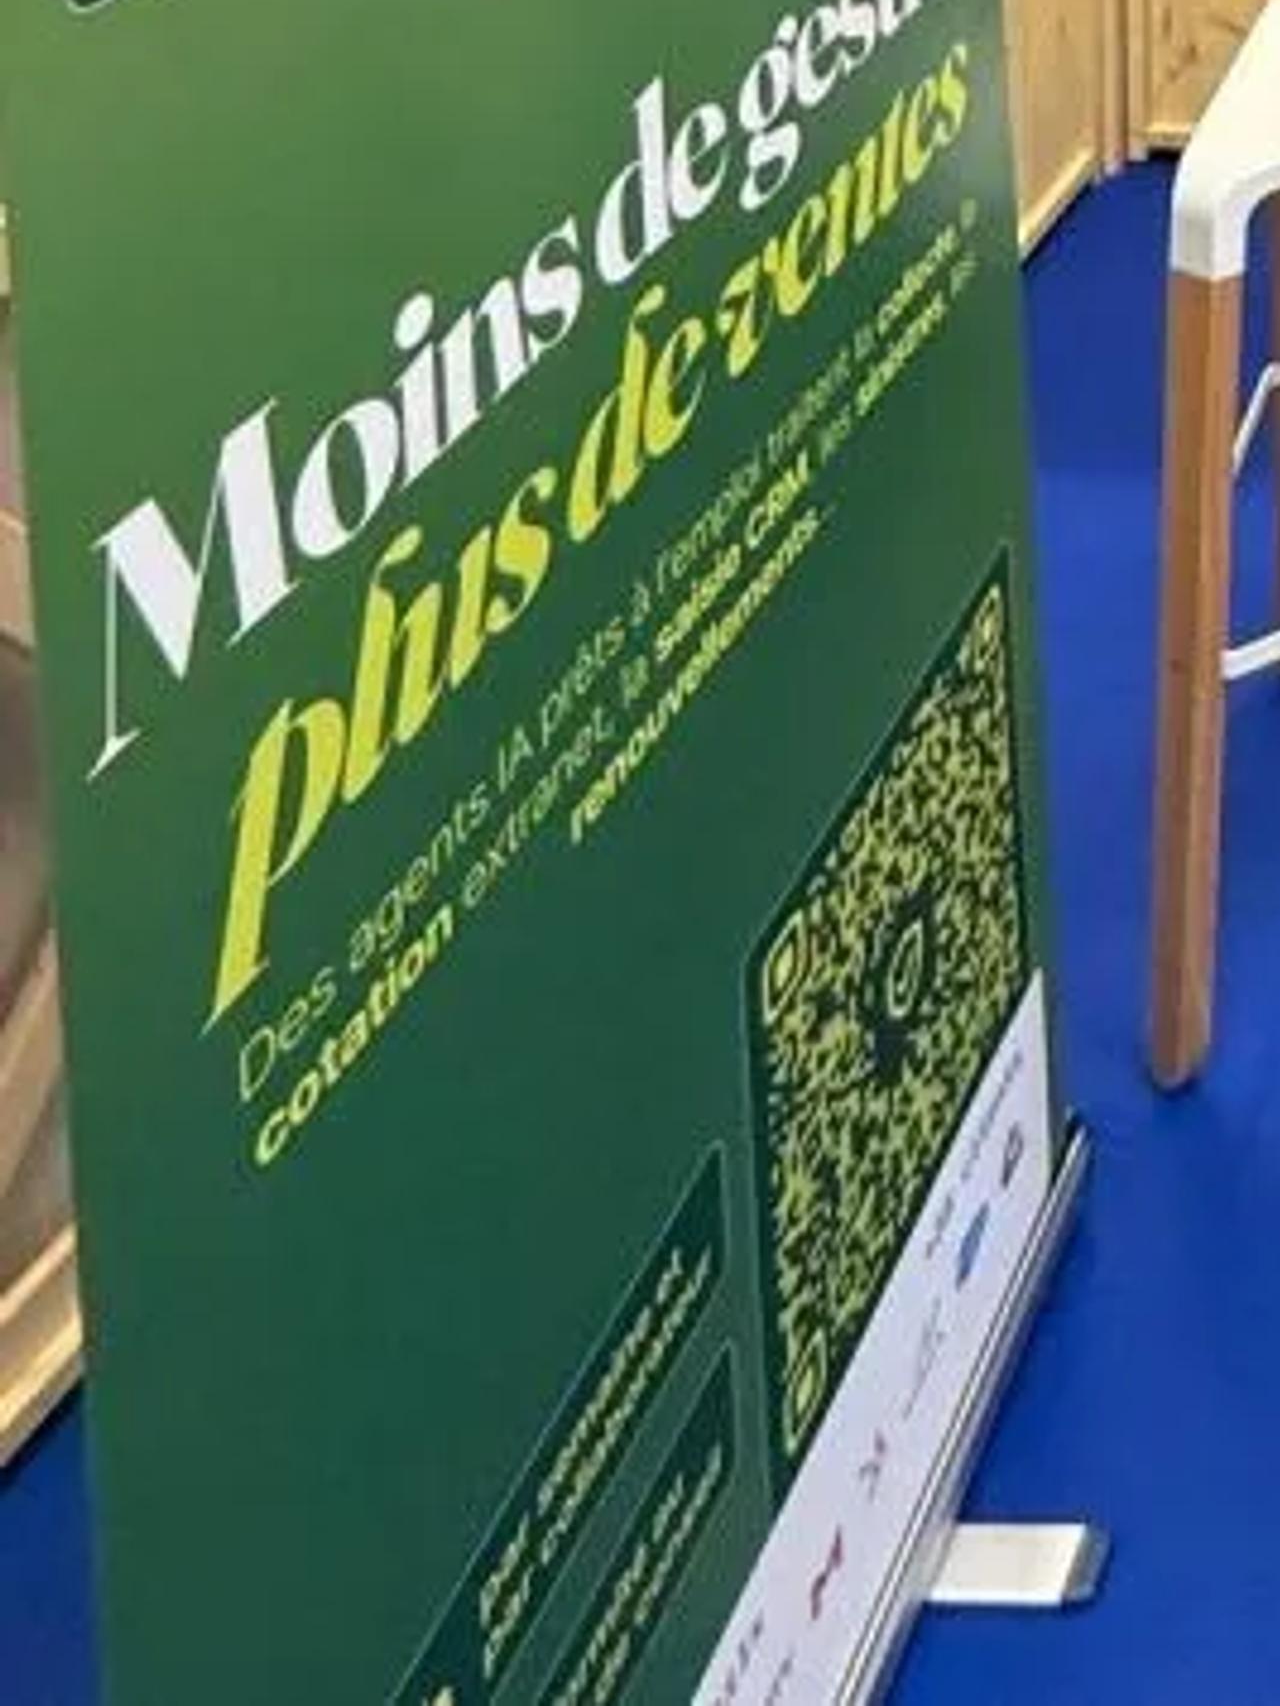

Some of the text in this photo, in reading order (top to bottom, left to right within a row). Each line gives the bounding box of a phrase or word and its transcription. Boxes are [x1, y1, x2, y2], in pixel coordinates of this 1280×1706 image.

[86, 214, 584, 781] Moins
[597, 76, 728, 284] de
[199, 41, 972, 1039] plus de ventes
[239, 965, 338, 1103] Des
[348, 781, 492, 974] agents
[499, 725, 535, 793] IA
[541, 614, 627, 748] prêts
[254, 902, 456, 1166] cotation
